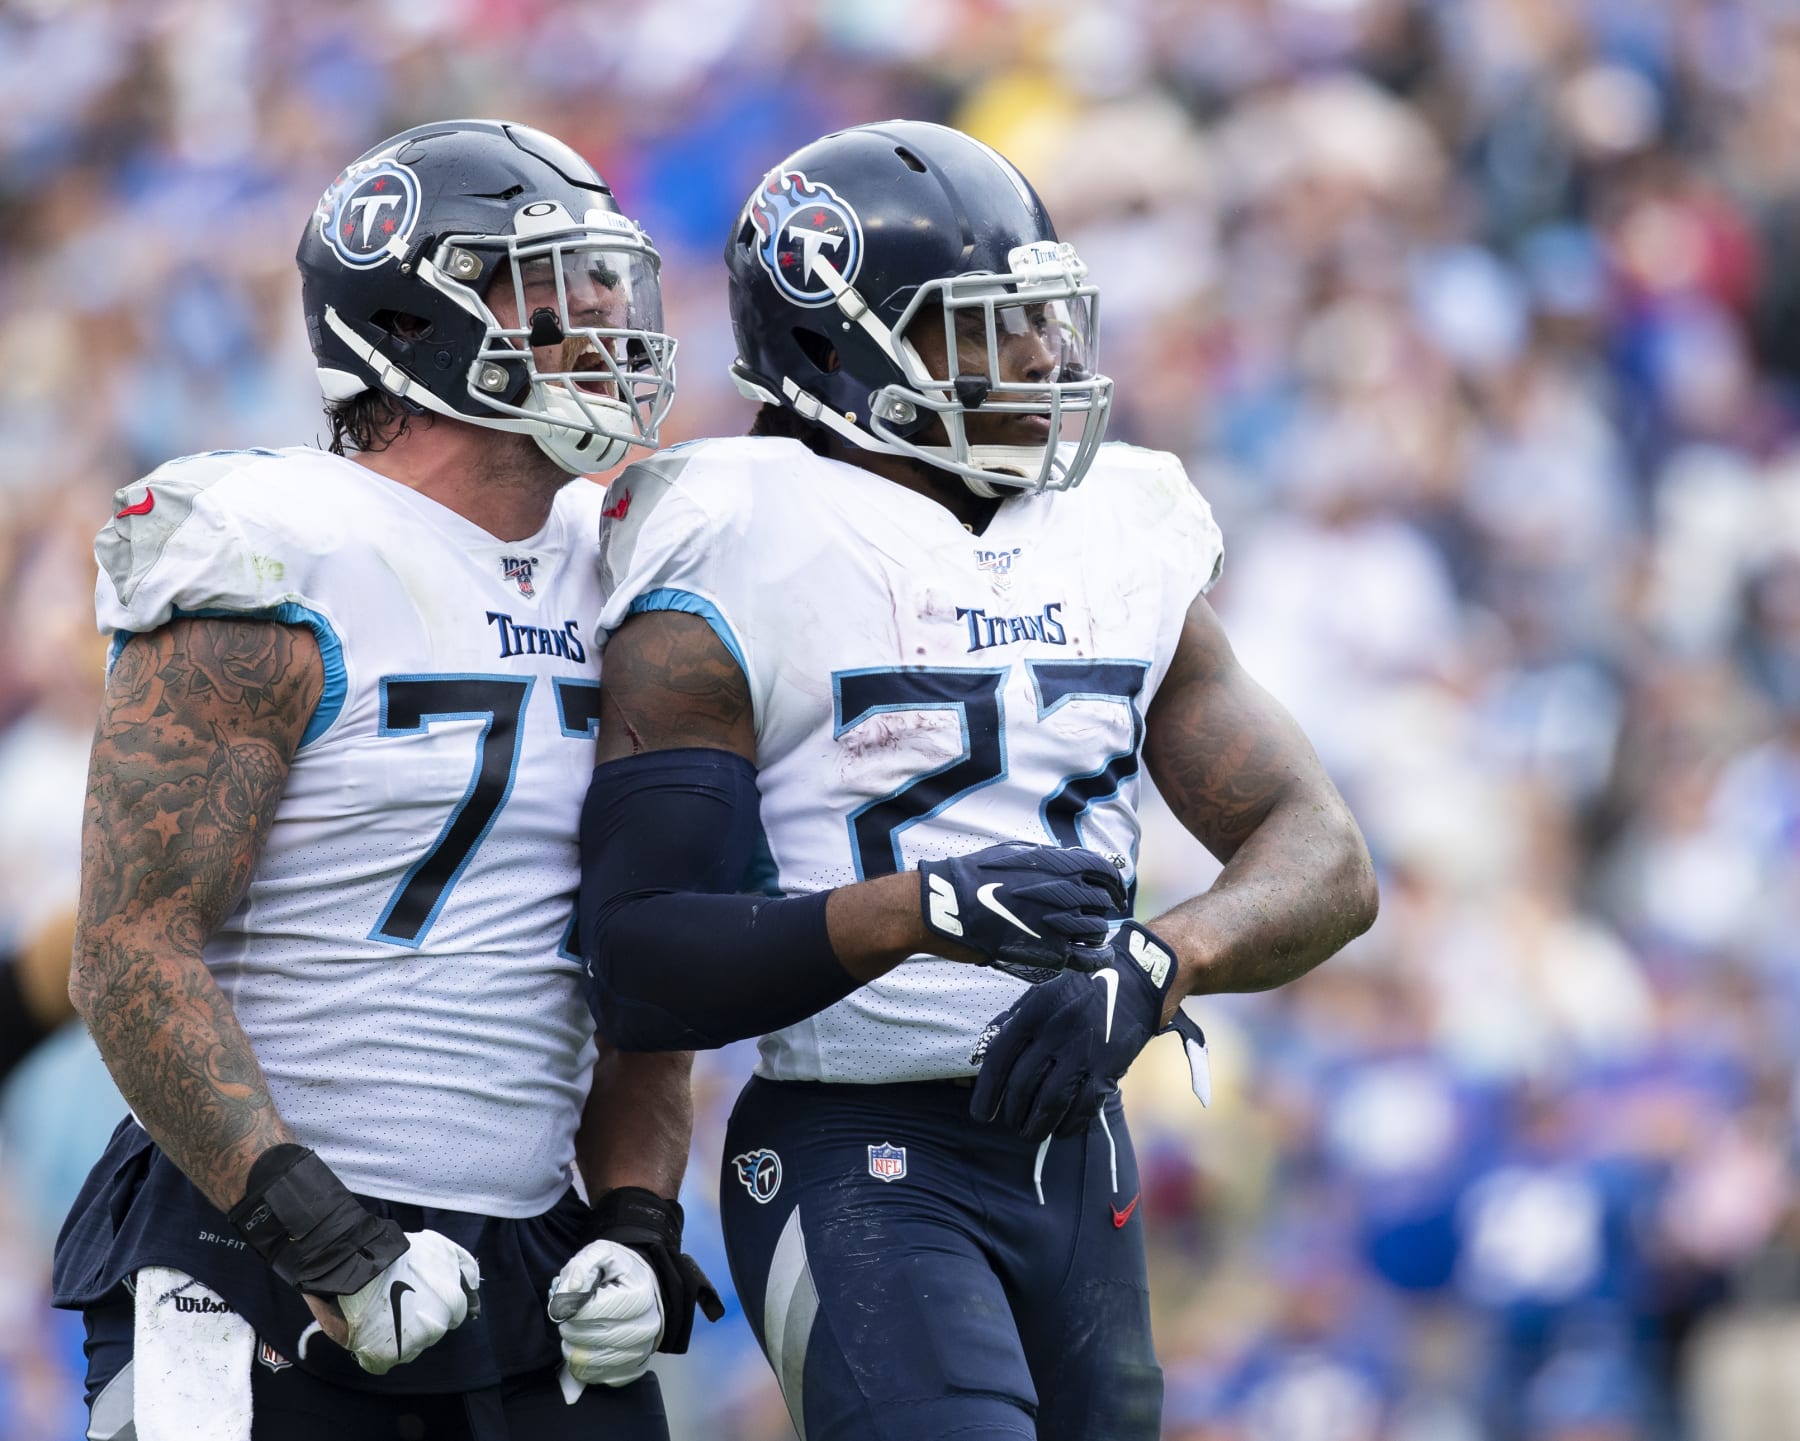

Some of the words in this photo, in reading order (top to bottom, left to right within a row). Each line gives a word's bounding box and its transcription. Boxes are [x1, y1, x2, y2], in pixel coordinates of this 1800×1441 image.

[486, 611, 585, 664] TITANS
[955, 603, 1067, 653] TITANS
[874, 1158, 902, 1175] NFL
[198, 1231, 248, 1251] DRI-FIT
